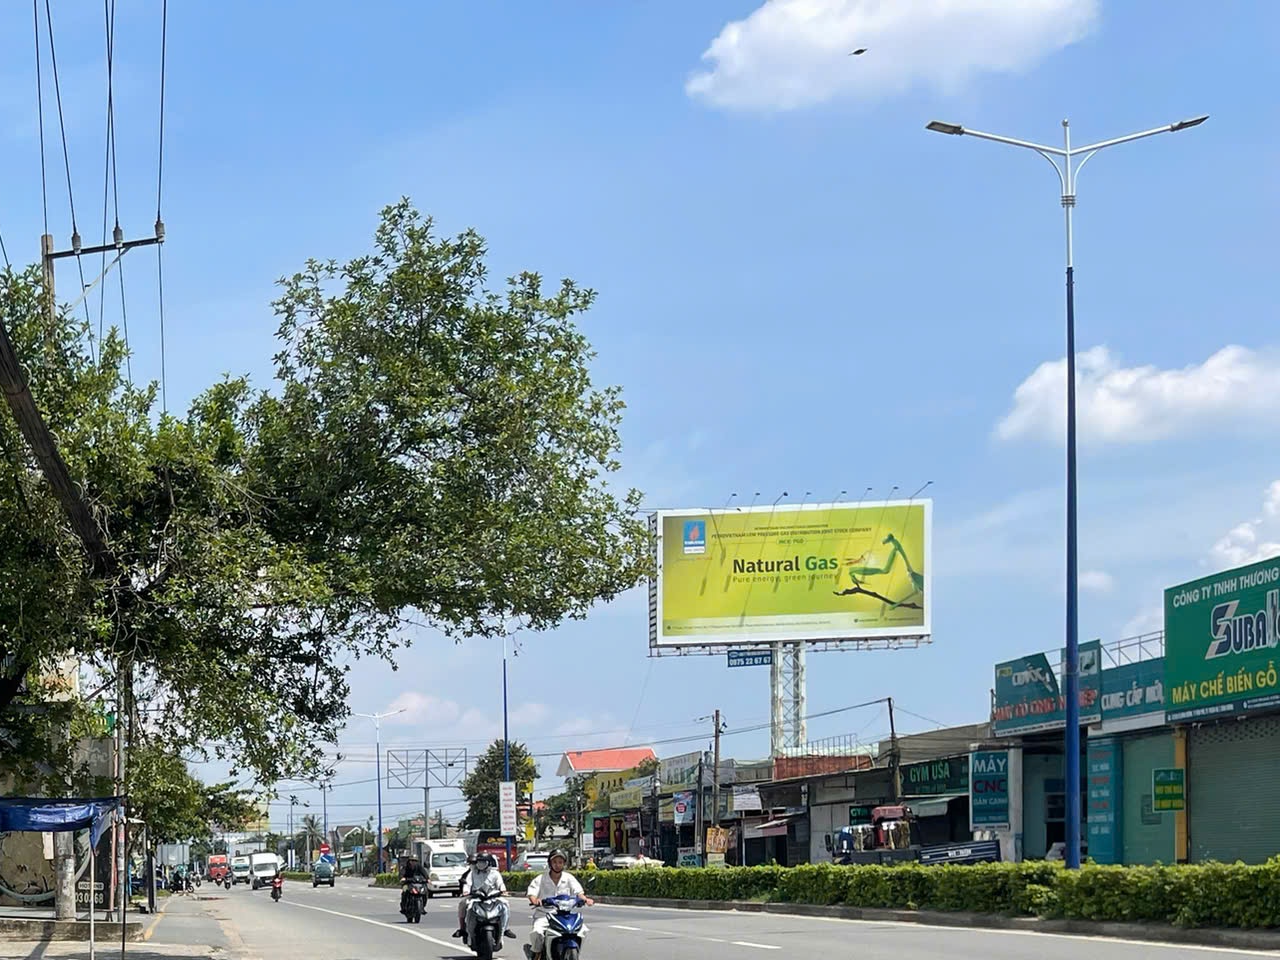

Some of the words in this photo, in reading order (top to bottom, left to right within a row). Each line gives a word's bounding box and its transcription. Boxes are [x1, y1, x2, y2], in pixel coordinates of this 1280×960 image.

[733, 556, 800, 574] Natural
[805, 556, 838, 571] Gas
[1173, 589, 1199, 608] CÔNG
[1201, 585, 1212, 600] TY
[1214, 578, 1237, 597] TNHH
[1239, 566, 1279, 590] THƯƠNG
[1172, 681, 1197, 705] MÁY
[1200, 670, 1225, 698] CHẾ
[910, 765, 930, 782] GYM
[932, 762, 951, 780] USA
[973, 755, 1006, 773] MÁY
[973, 779, 1007, 794] CNC
